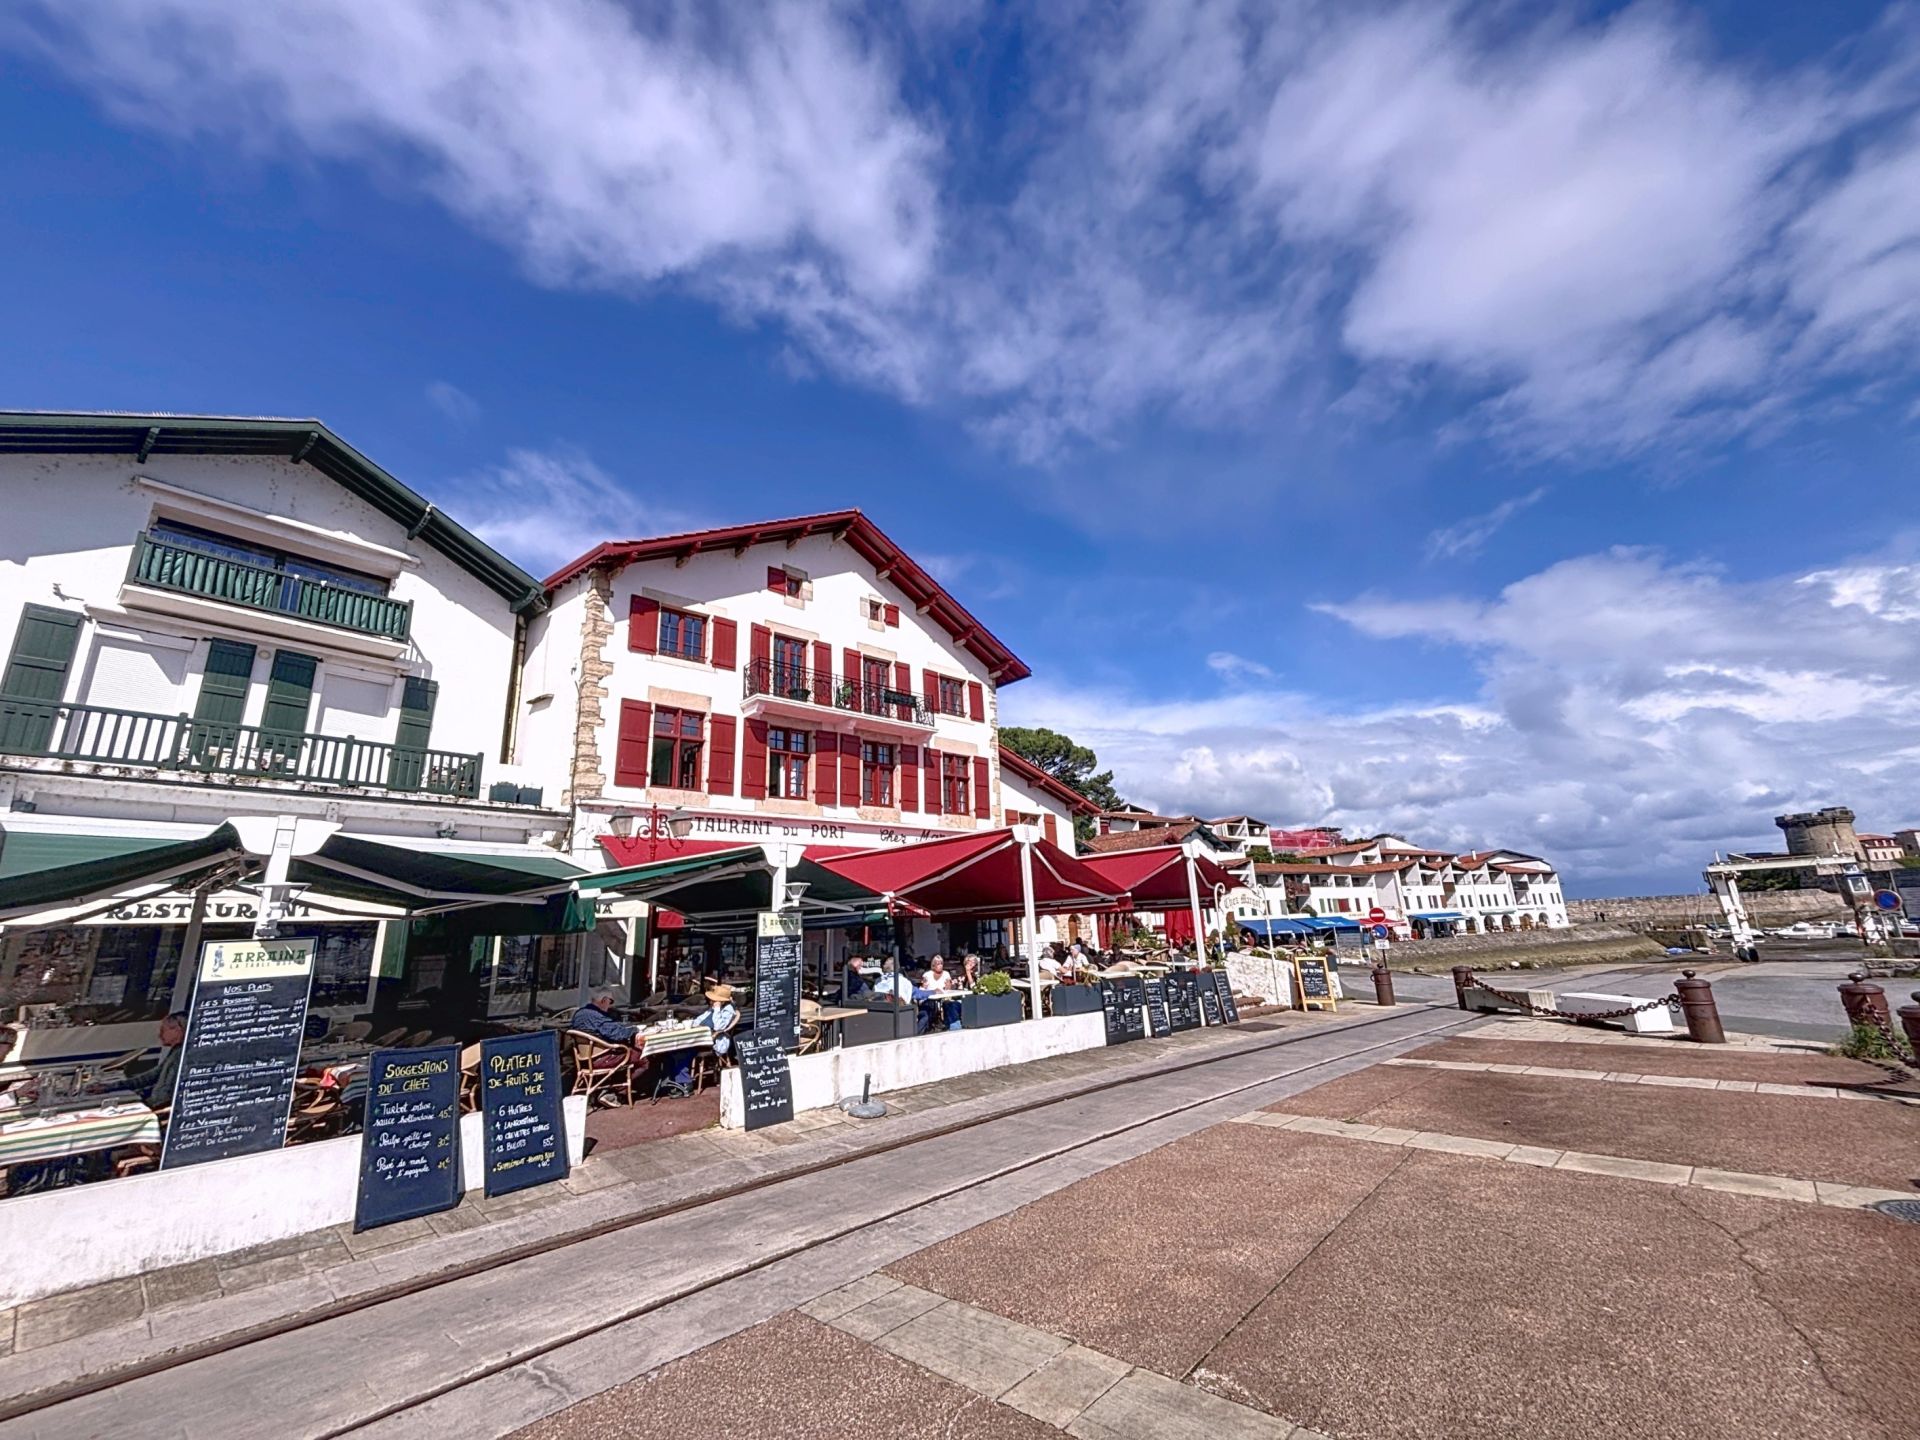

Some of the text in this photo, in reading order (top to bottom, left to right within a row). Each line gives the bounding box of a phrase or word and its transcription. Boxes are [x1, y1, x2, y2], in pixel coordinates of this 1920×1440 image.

[657, 813, 846, 838] RTAURANT DU PORT
[104, 903, 310, 920] RESTURNT
[224, 986, 242, 994] NOS
[200, 1000, 218, 1008] LES
[736, 1040, 754, 1049] MENU
[490, 1054, 540, 1074] PLATEAU
[488, 1072, 545, 1088] DE FRUITS DE
[378, 1084, 393, 1094] DU
[499, 1105, 506, 1117] 6
[495, 1121, 500, 1130] 4
[506, 1139, 526, 1151] BULOTS
